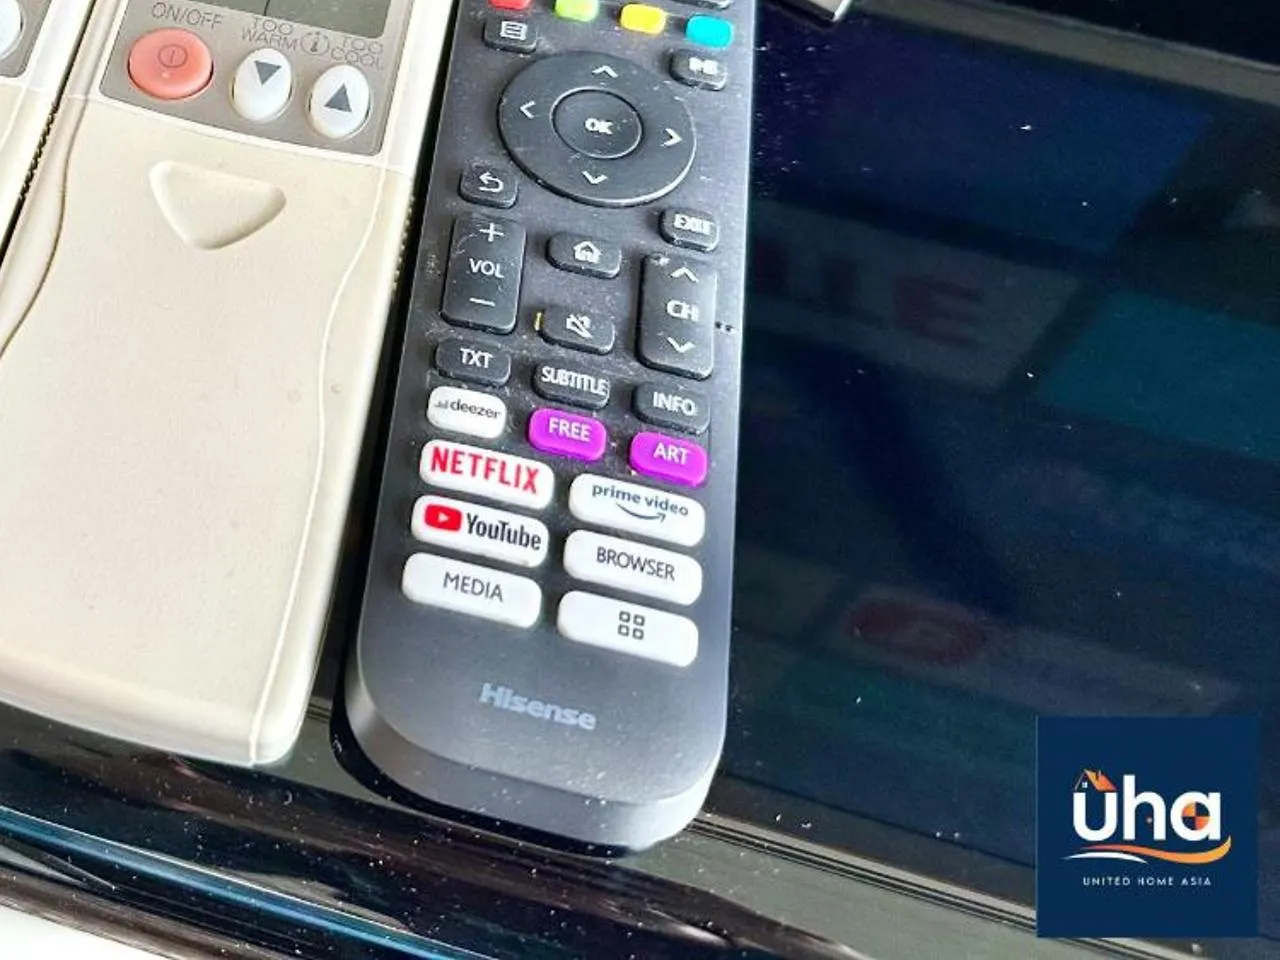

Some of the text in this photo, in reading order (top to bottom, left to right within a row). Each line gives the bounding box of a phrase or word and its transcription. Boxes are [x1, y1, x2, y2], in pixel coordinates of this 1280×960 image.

[151, 1, 224, 28] ON/OFF
[253, 17, 293, 35] TOO
[241, 26, 298, 51] WARM
[584, 118, 614, 136] OK
[673, 213, 714, 236] EXIT
[469, 257, 505, 279] VOL
[666, 299, 699, 323] CH
[459, 348, 493, 369] TXT
[540, 365, 609, 394] SUBTITLE
[449, 398, 502, 420] deezer
[652, 391, 697, 414] INFO
[548, 417, 591, 443] FREE
[653, 441, 690, 466] ART
[430, 446, 541, 495] NETFLIX
[592, 482, 690, 517] prime video
[465, 512, 542, 551] YouTube
[596, 546, 676, 582] BROWSER
[442, 571, 504, 603] MEDIA
[479, 682, 597, 730] Hisense
